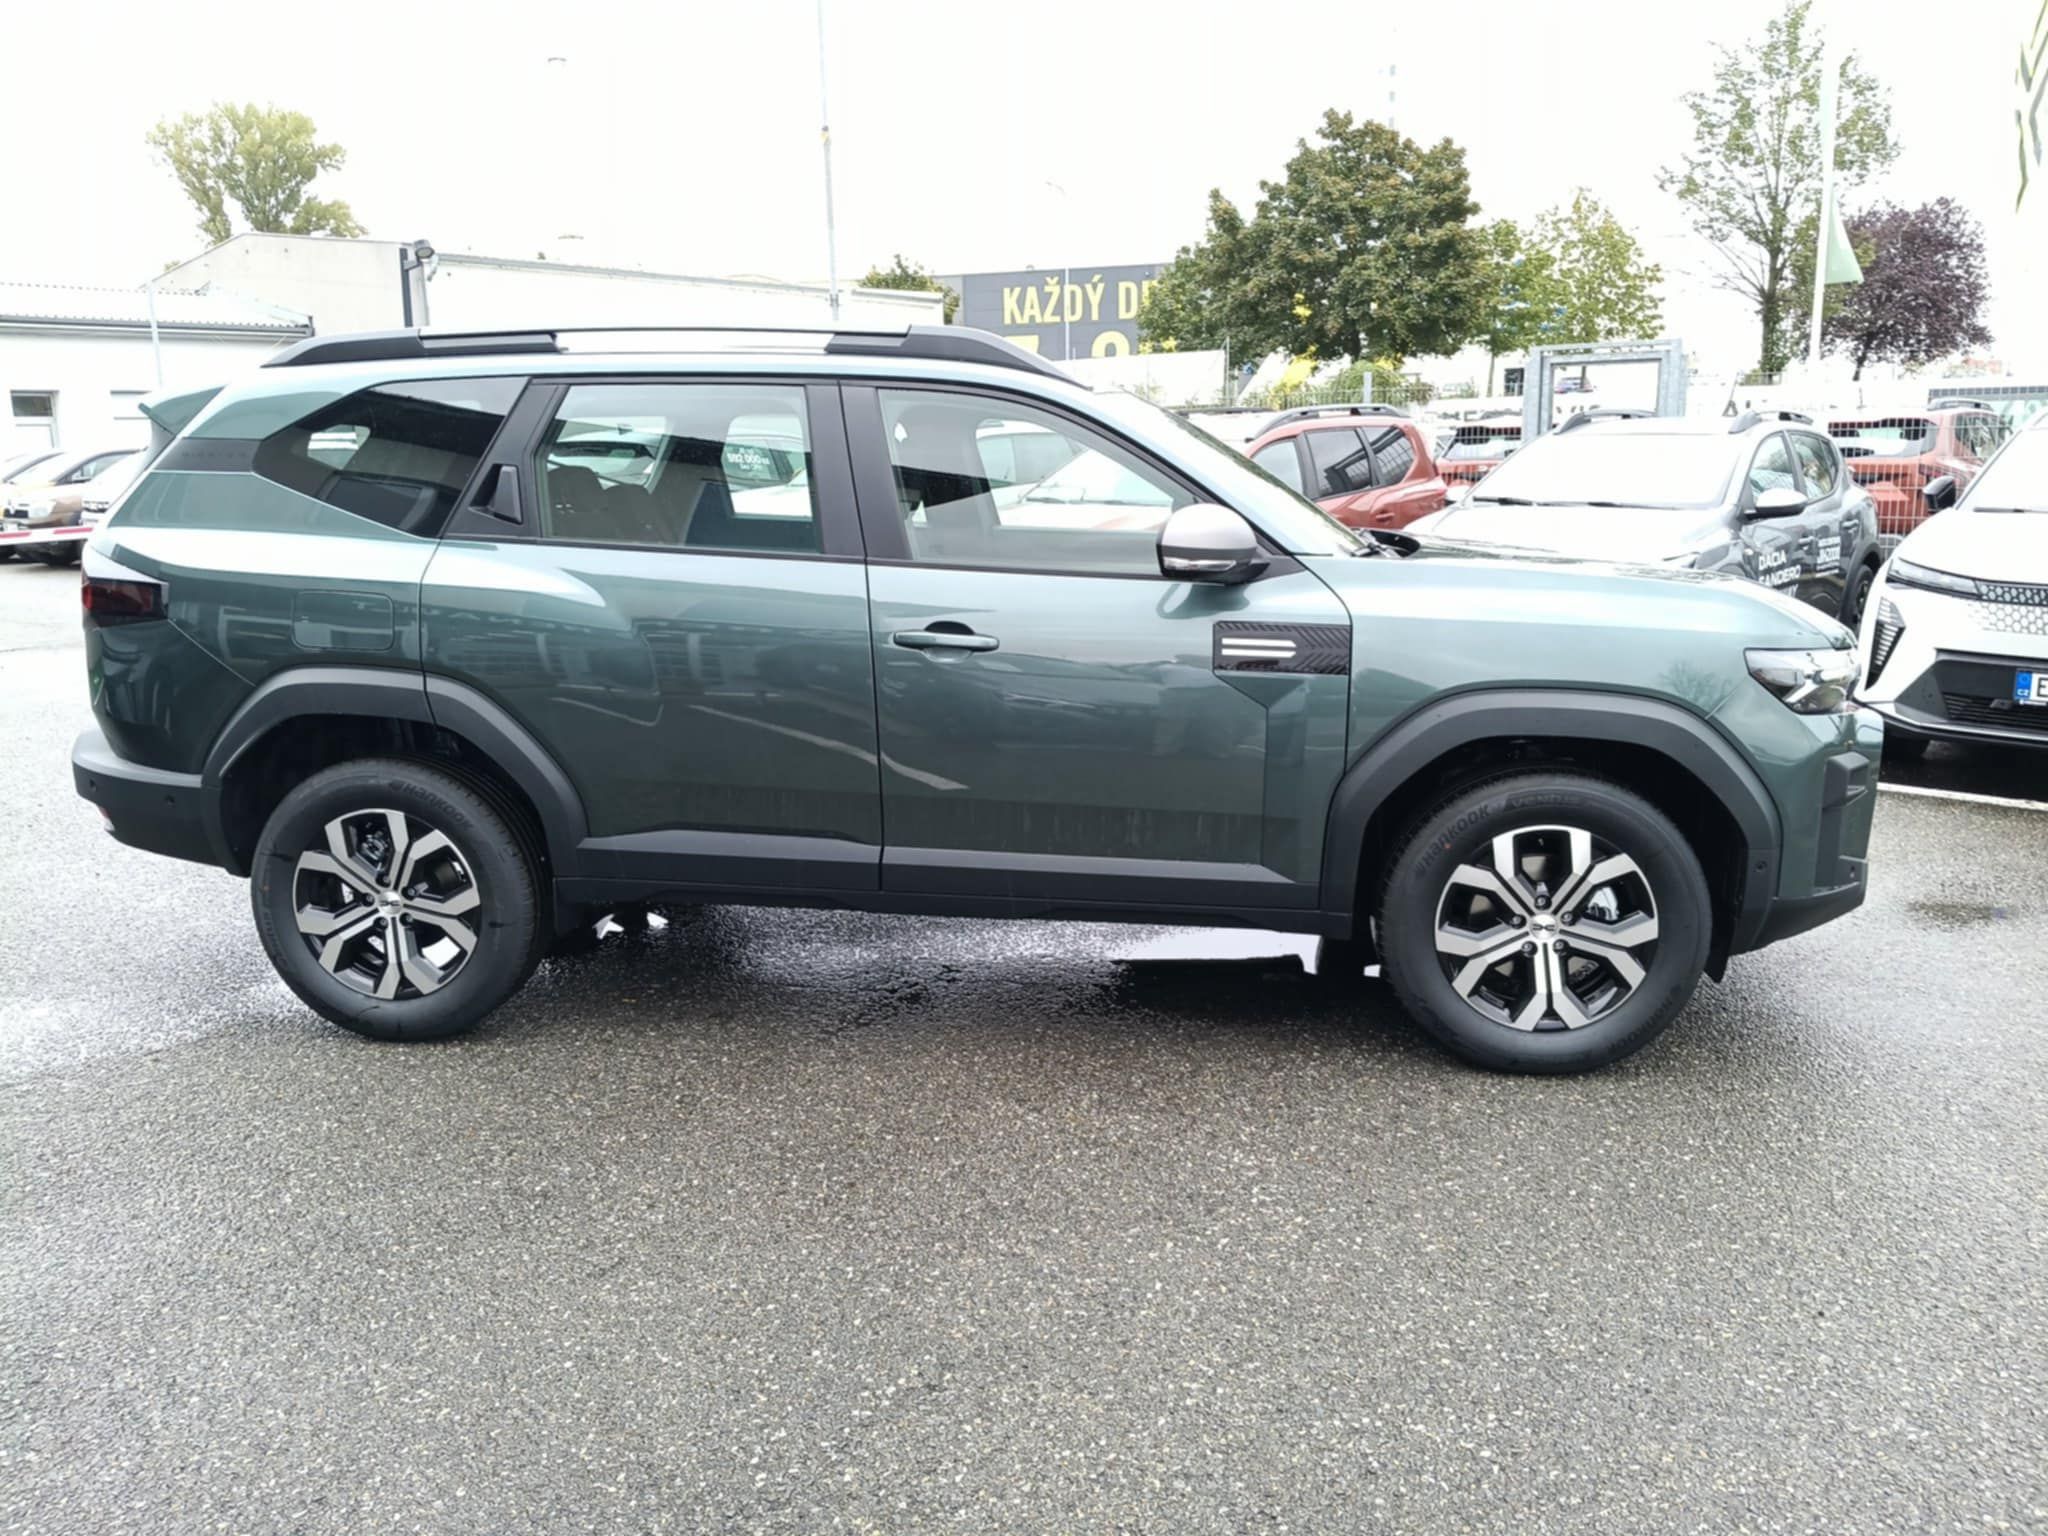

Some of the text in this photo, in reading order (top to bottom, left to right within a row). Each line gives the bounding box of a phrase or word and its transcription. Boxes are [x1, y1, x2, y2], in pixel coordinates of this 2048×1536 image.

[1003, 274, 1105, 325] KAŽDÝ
[1759, 549, 1787, 571] DACIA
[1759, 565, 1801, 586] SANDERO
